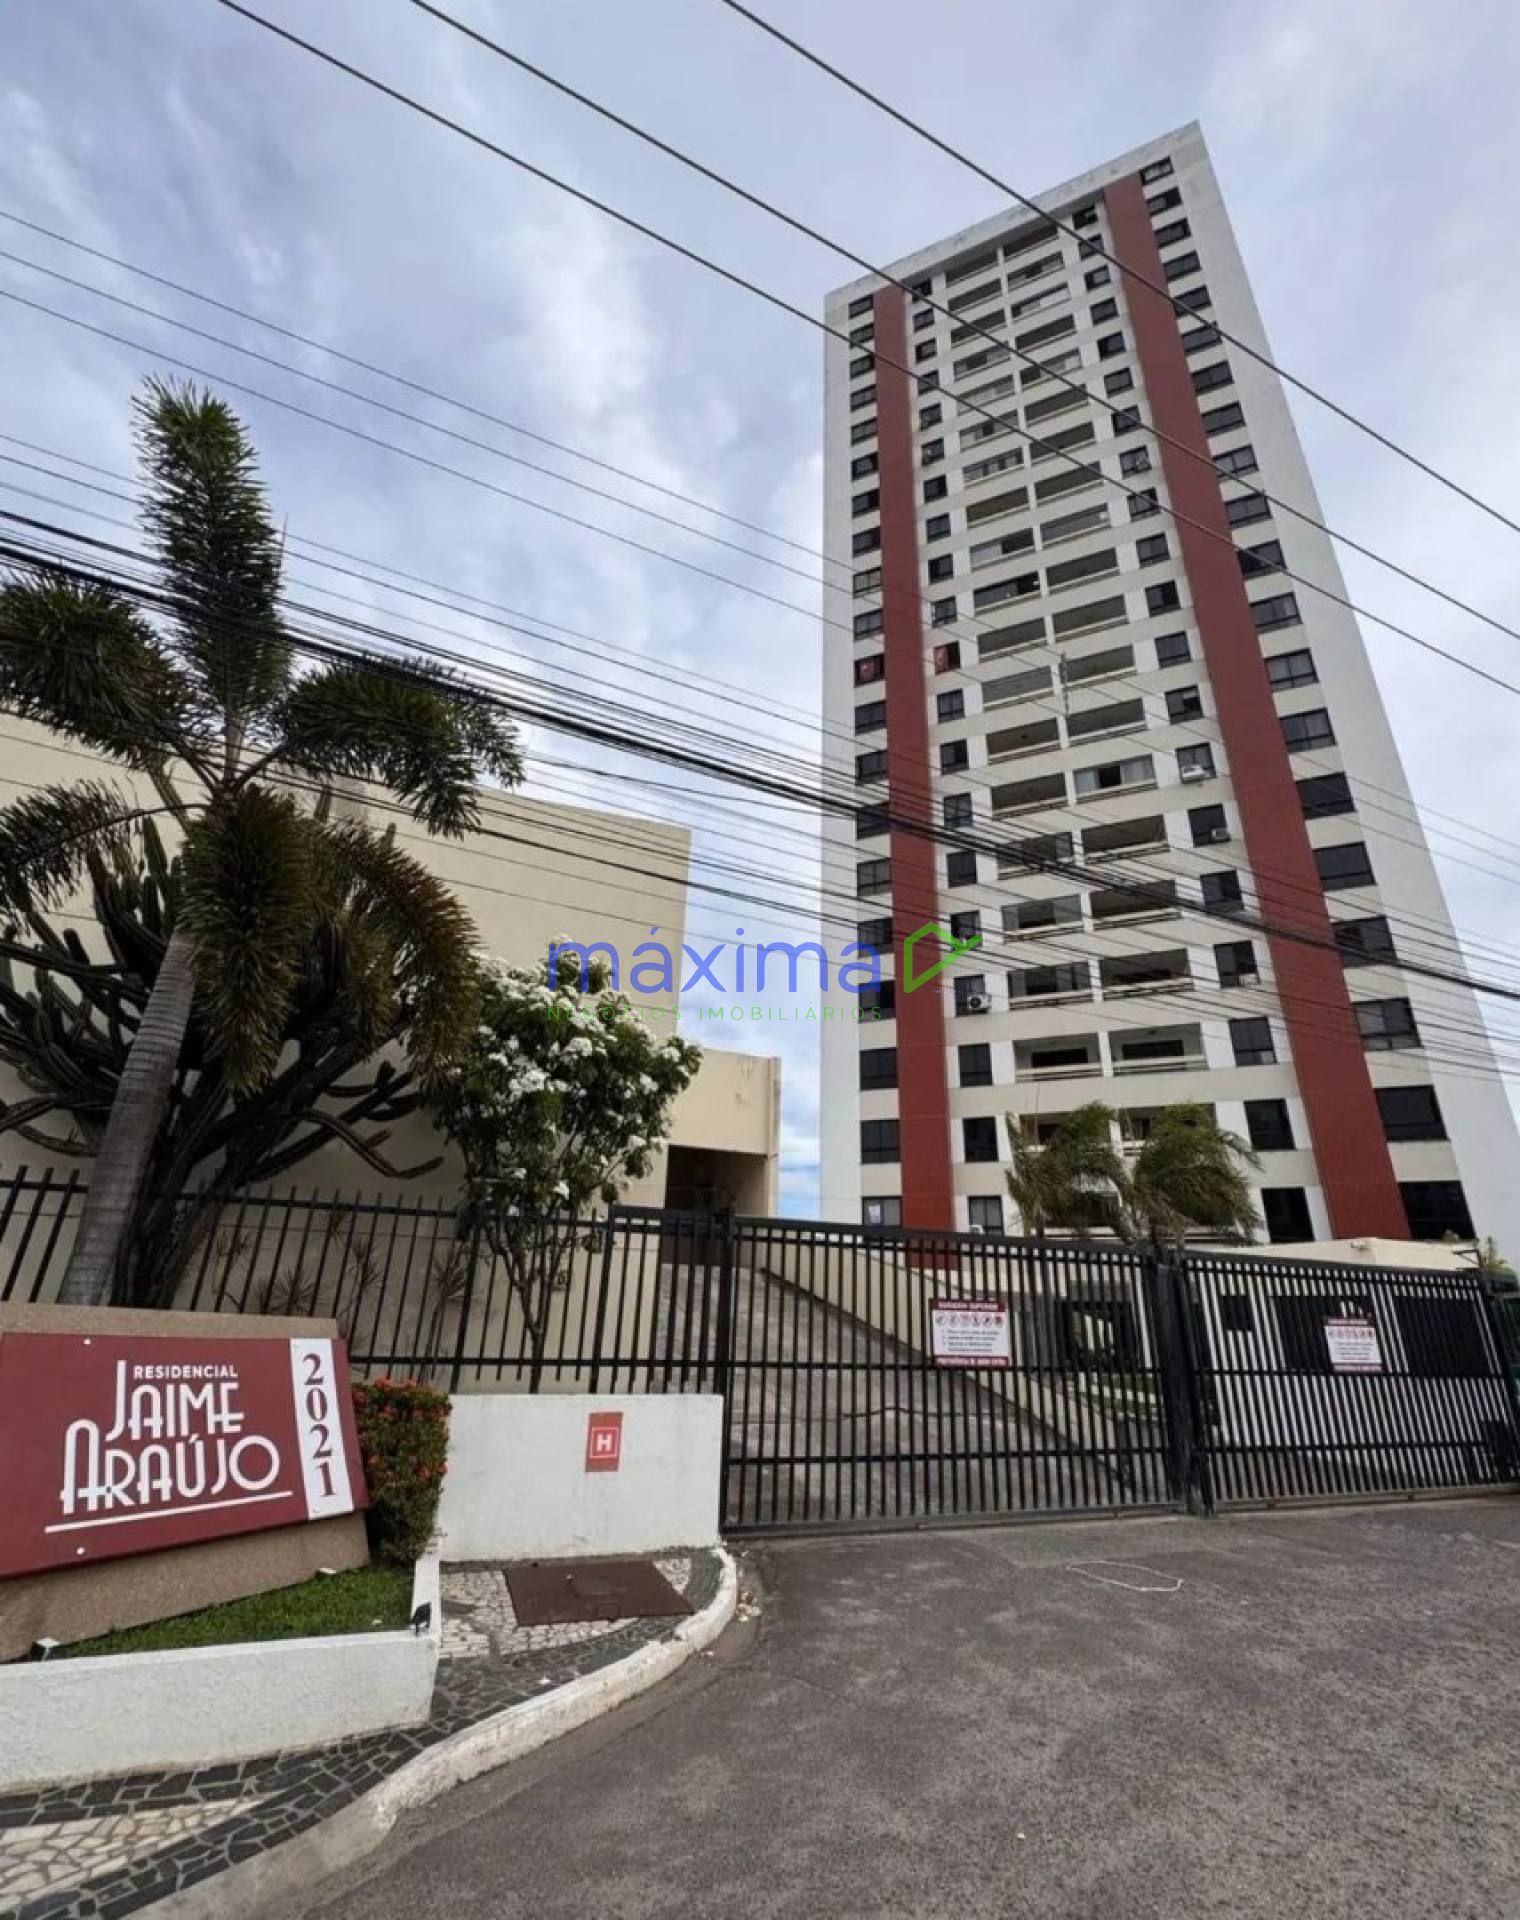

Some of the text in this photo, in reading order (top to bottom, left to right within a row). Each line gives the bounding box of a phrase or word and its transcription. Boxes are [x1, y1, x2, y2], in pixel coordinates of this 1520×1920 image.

[134, 1364, 238, 1379] RESIDENCIAL
[302, 1352, 338, 1498] 2021
[596, 1433, 613, 1452] H
